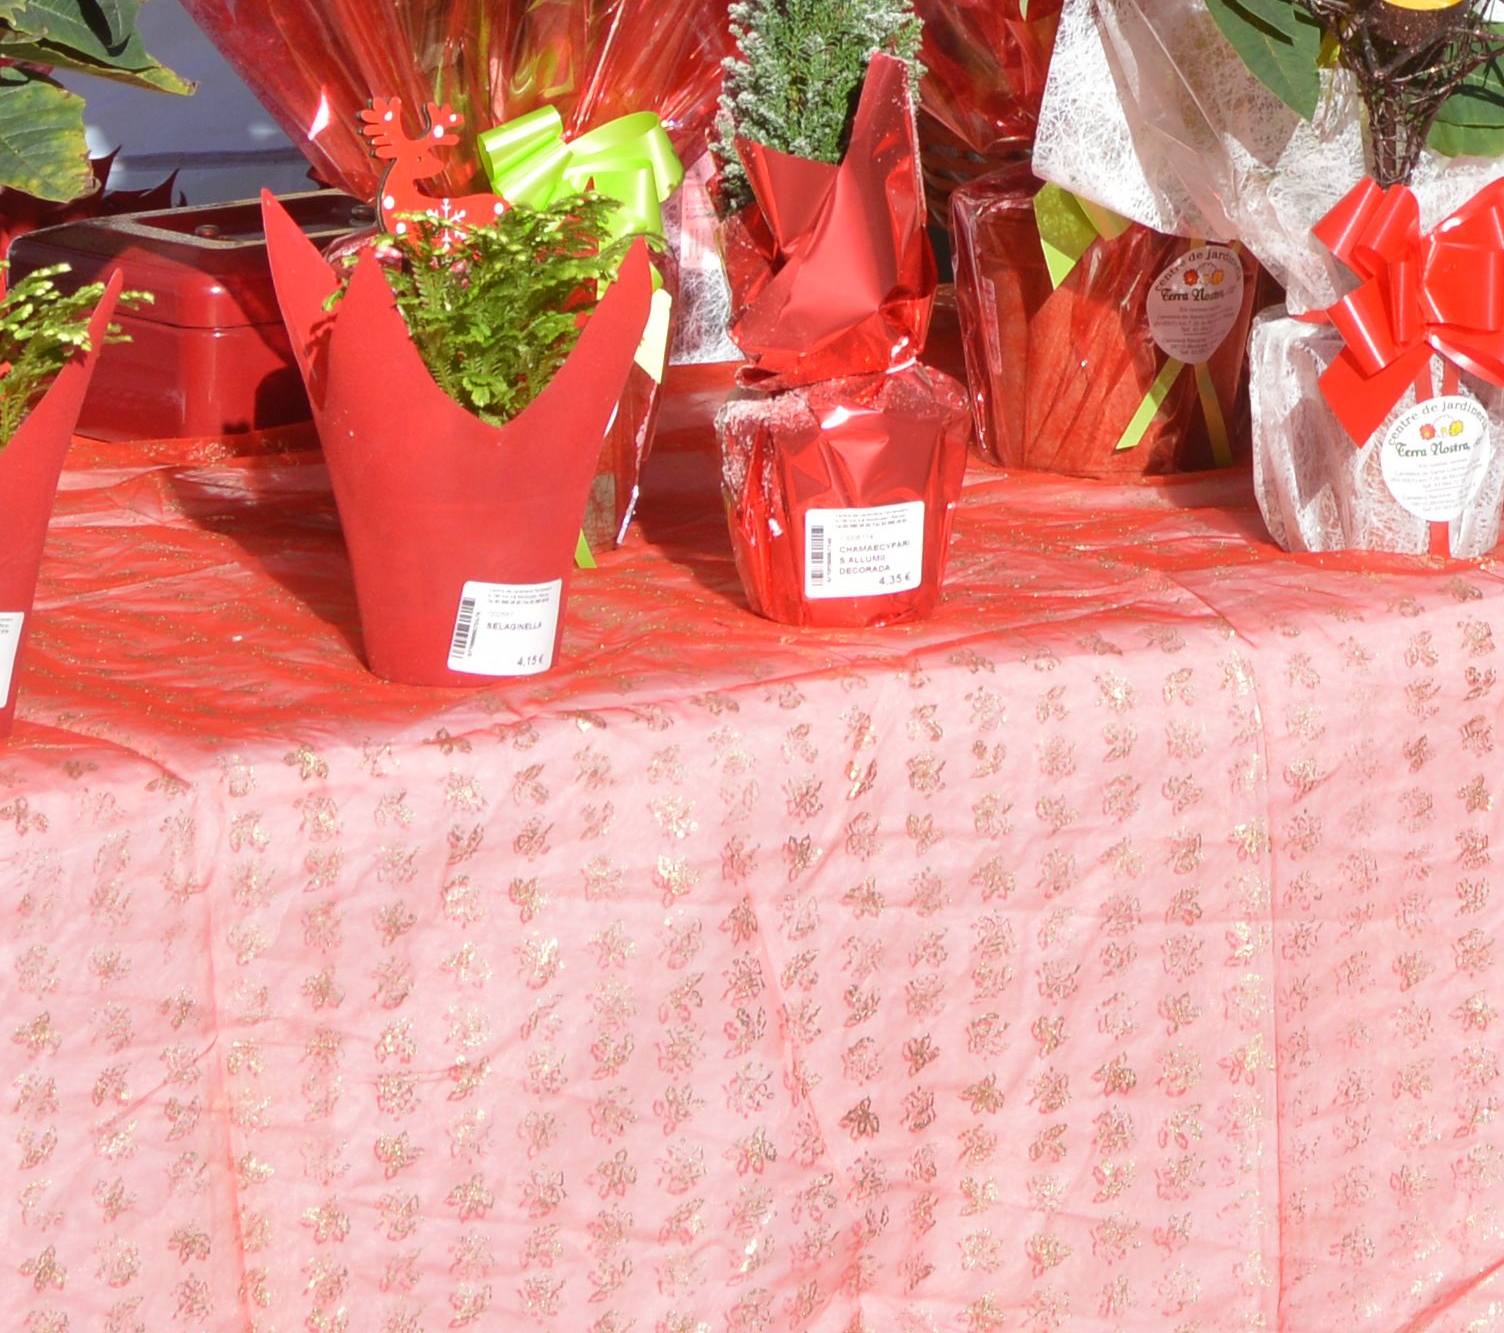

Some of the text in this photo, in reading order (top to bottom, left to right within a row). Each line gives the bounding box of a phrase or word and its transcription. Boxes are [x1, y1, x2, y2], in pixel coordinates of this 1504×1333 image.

[1161, 288, 1189, 302] Terra
[1387, 413, 1419, 447] centre
[1421, 404, 1438, 416] de
[1395, 440, 1471, 458] Terra Nostra
[839, 564, 891, 576] DECORADA
[487, 620, 543, 632] SELAGINELLA
